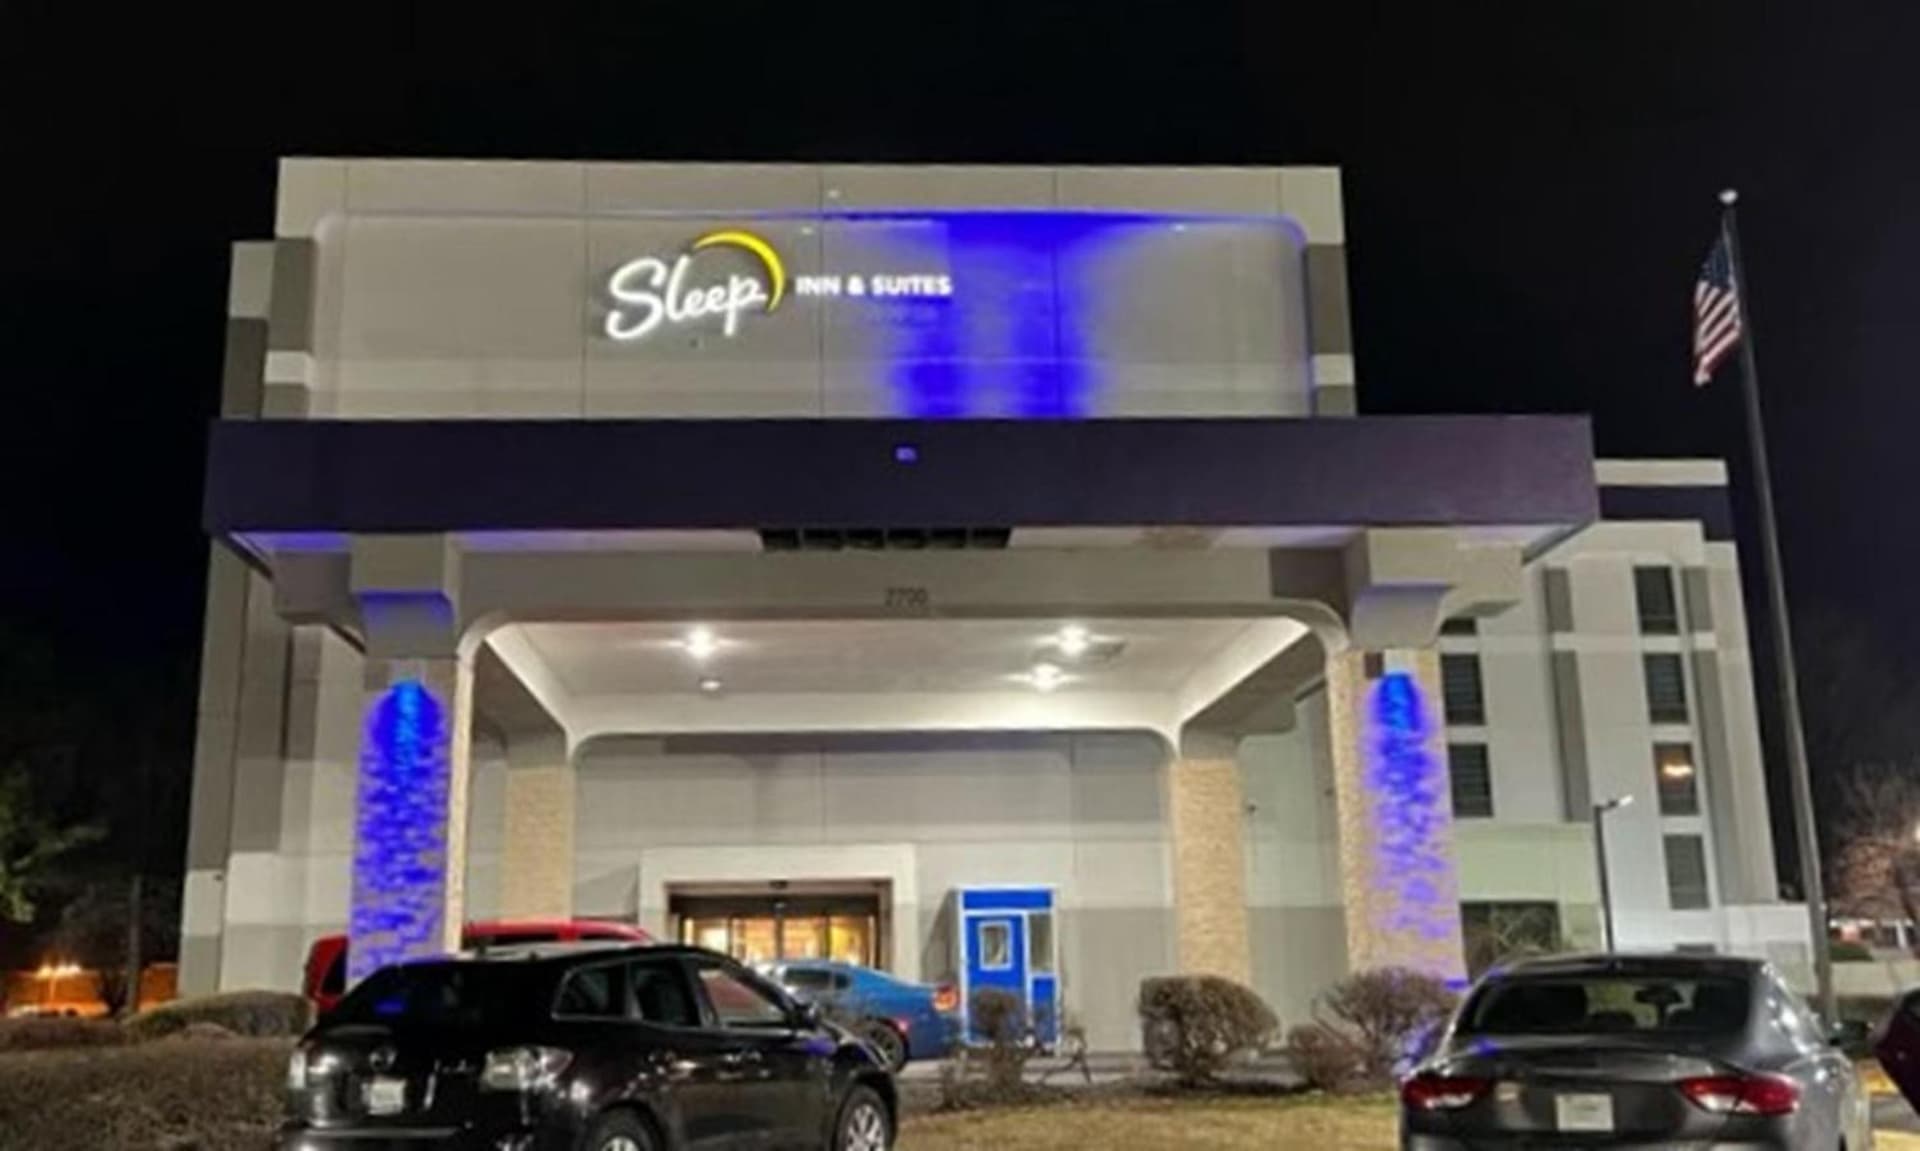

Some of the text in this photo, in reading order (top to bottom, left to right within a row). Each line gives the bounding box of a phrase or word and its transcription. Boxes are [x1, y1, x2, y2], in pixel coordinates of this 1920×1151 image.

[606, 255, 951, 339] Sleep INN & SUITES
